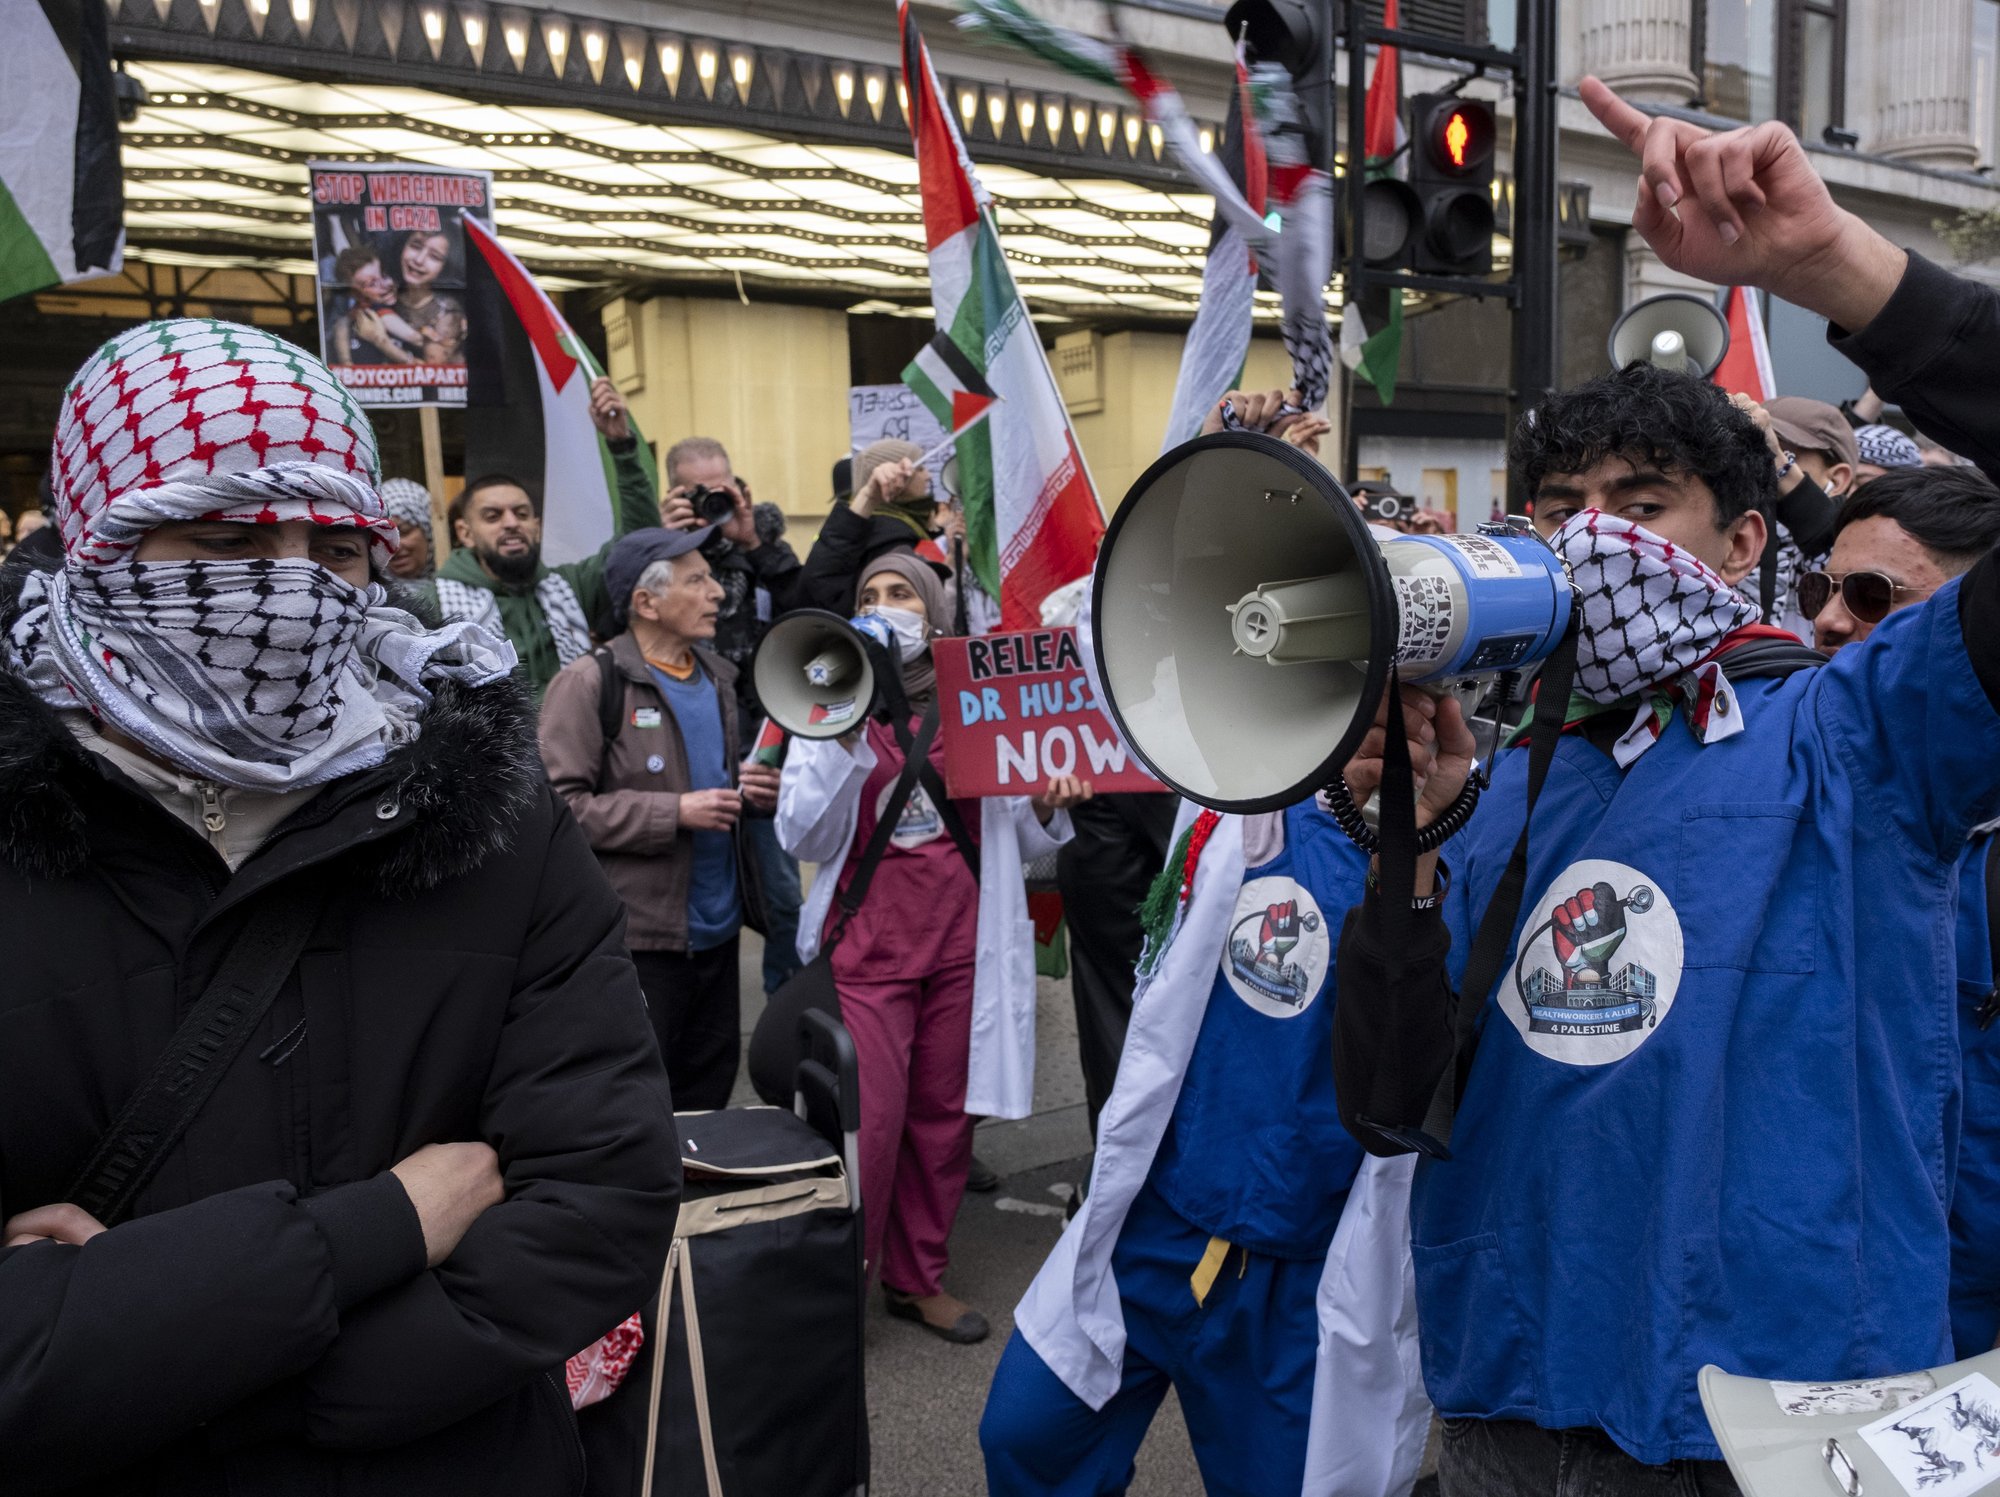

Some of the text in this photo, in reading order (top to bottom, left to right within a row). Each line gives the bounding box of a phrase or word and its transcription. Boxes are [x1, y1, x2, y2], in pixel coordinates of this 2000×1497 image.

[314, 173, 486, 207] STOP WARCRIMES
[364, 206, 442, 232] IN GAZA
[1429, 577, 1452, 660] STOP
[958, 687, 1007, 727] DR
[995, 724, 1128, 785] NOW
[1533, 1008, 1604, 1022] HEALTHWORKERS
[1611, 1006, 1637, 1019] ALLIES
[1550, 1024, 1621, 1035] 4 PALESTINE
